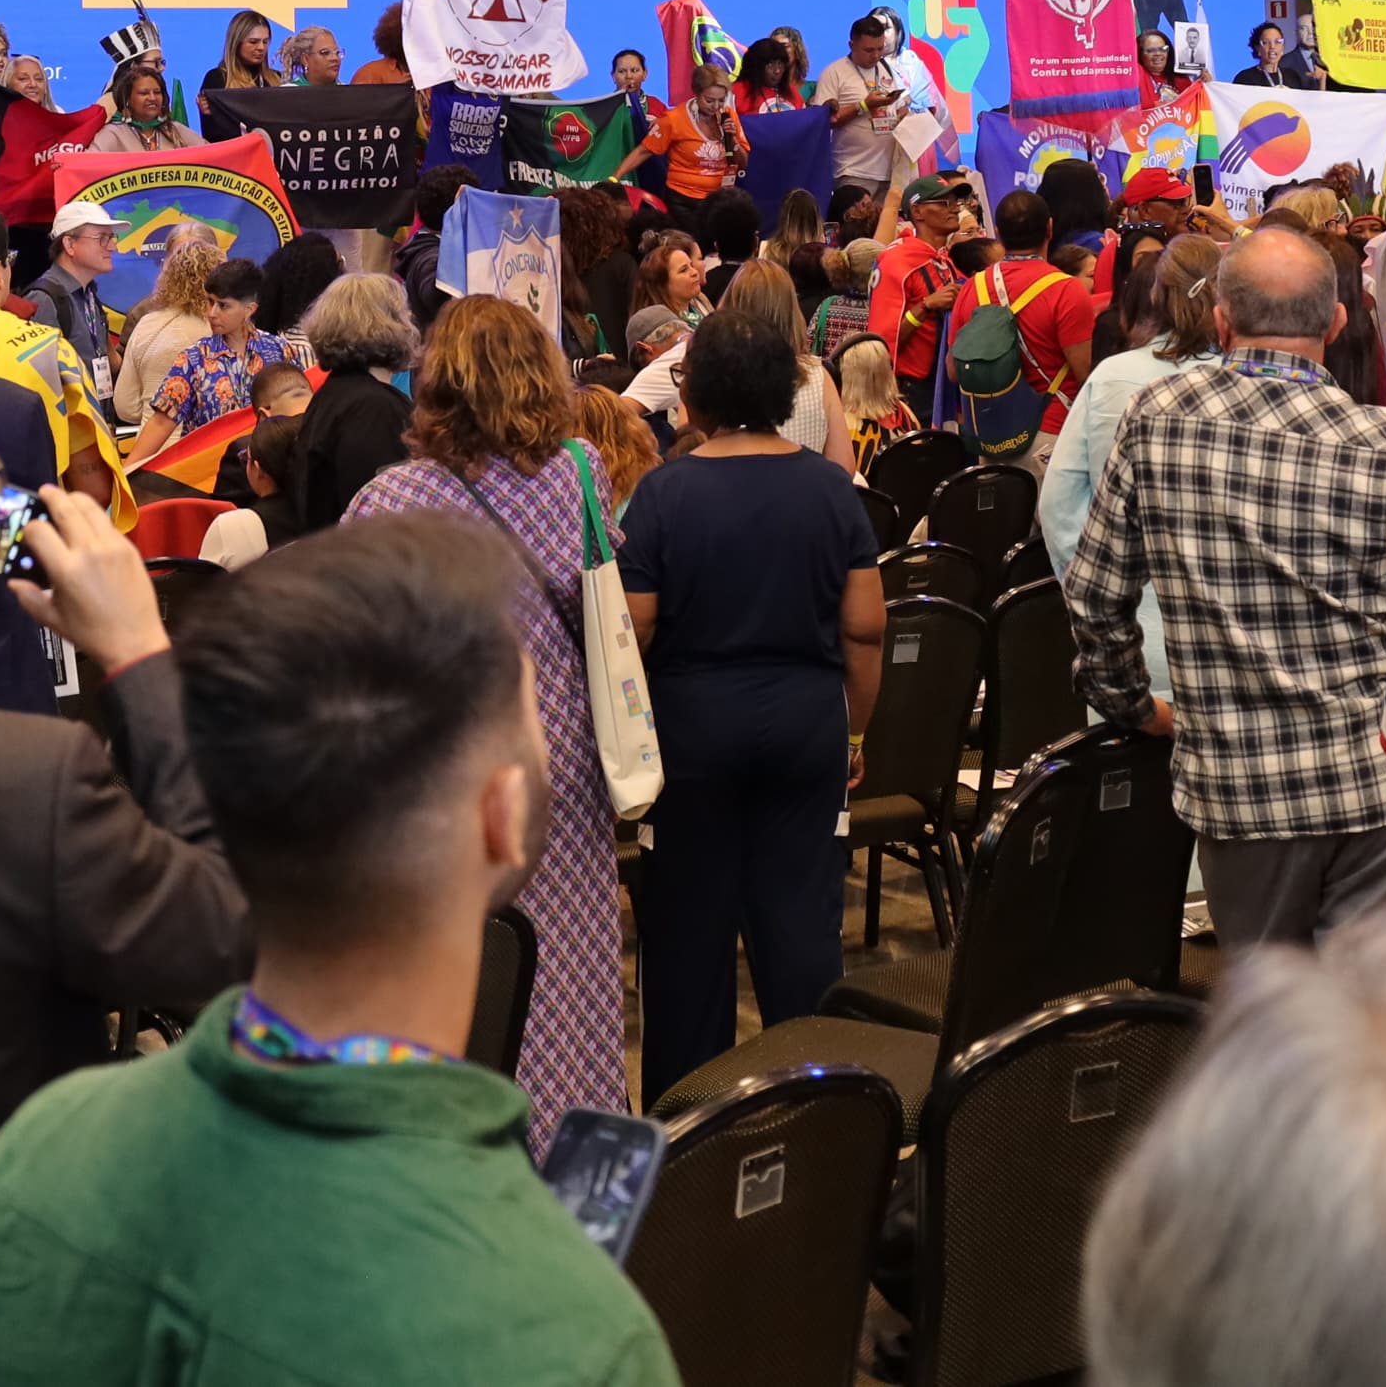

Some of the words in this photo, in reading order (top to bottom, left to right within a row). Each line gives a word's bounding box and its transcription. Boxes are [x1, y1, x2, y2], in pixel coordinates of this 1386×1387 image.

[501, 53, 552, 71] LGAR
[471, 72, 552, 90] GRAMAME
[1031, 68, 1068, 77] Contra
[280, 125, 401, 142] COALIZÃO
[1136, 106, 1192, 147] MOVIMENO
[280, 143, 399, 172] NEGRA
[90, 182, 119, 200] LUTA
[120, 176, 138, 190] EM
[140, 170, 181, 184] DEFESA
[184, 170, 198, 182] DA
[201, 171, 264, 201] POPULAÇÃO
[262, 195, 280, 215] EM
[317, 176, 398, 191] DIREITOS
